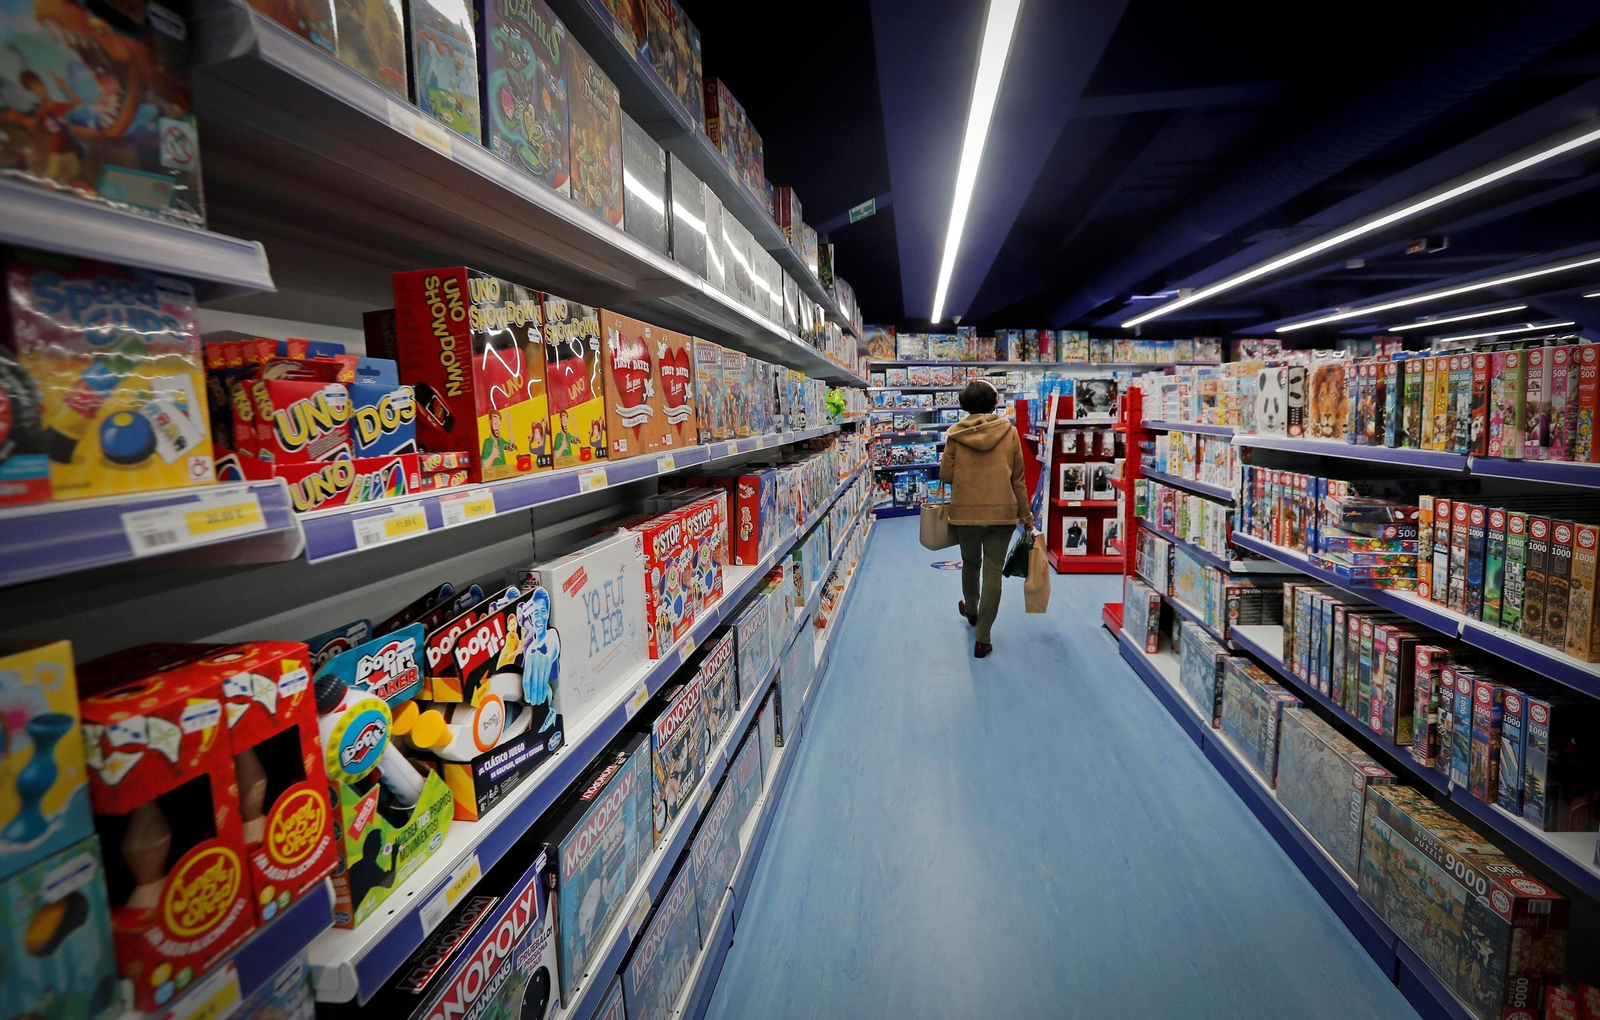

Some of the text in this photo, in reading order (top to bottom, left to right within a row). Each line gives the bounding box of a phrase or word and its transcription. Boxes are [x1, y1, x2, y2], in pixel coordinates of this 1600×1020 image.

[443, 278, 466, 322] UNO
[469, 278, 500, 304] UNO
[470, 300, 543, 333] SHOWDOWN
[544, 301, 568, 322] UNO
[424, 275, 463, 397] SHOWDOWN
[544, 318, 600, 345] SHOWDOWN
[614, 357, 649, 373] FIRST DATES
[662, 366, 688, 378] FIRST DATES
[1529, 370, 1541, 378] 500
[252, 380, 275, 421] UNO
[502, 375, 524, 398] UNO
[568, 376, 585, 399] UNO
[1579, 383, 1595, 391] emoji
[357, 387, 416, 443] DOS
[423, 454, 442, 471] UNO
[289, 461, 354, 511] UNO
[693, 508, 712, 534] STOP
[1398, 529, 1417, 538] 500
[1436, 521, 1449, 529] 1000
[1453, 525, 1467, 533] 1000
[1469, 528, 1484, 537] 1000
[660, 522, 680, 555] STOP
[1488, 532, 1504, 541] 1000
[1507, 537, 1524, 547] 1000
[1528, 542, 1547, 552] 1000
[1552, 547, 1571, 558] 1000
[1574, 552, 1595, 563] 1000
[582, 575, 625, 625] YO FUI
[588, 624, 600, 658] A
[601, 608, 624, 648] EGB
[740, 609, 767, 648] MONOPOLY
[455, 618, 506, 669] bop it!
[358, 649, 397, 682] bop
[703, 639, 732, 685] MONOPOLY
[1416, 669, 1429, 680] 1500
[371, 667, 418, 700] AKER
[1439, 687, 1454, 699] 1000
[659, 683, 701, 746] MONOPOLY
[1474, 705, 1491, 718] 1000
[1502, 714, 1521, 728] 1000
[1267, 714, 1276, 747] 5000
[1528, 724, 1548, 739] 1000
[343, 730, 373, 765] bop
[484, 753, 508, 772] CLÁSICO
[508, 743, 525, 759] JUEGO
[581, 764, 614, 799] MONOPOLY
[354, 797, 376, 832] APRIETA
[418, 790, 452, 829] TUS PROPIOS
[1350, 791, 1362, 831] 4000
[565, 773, 632, 877] MONOPOLY
[695, 785, 733, 872] MONOPOLY
[1414, 837, 1443, 863] PUZZLE
[1418, 830, 1445, 854] EDUCA
[1444, 853, 1487, 896] 9000
[408, 898, 487, 987] MONOPOLY
[634, 874, 689, 988] MONOPOLY
[522, 941, 548, 975] PRESIONA
[1508, 980, 1516, 1005] PUZZLE
[1513, 977, 1529, 1008] 9000
